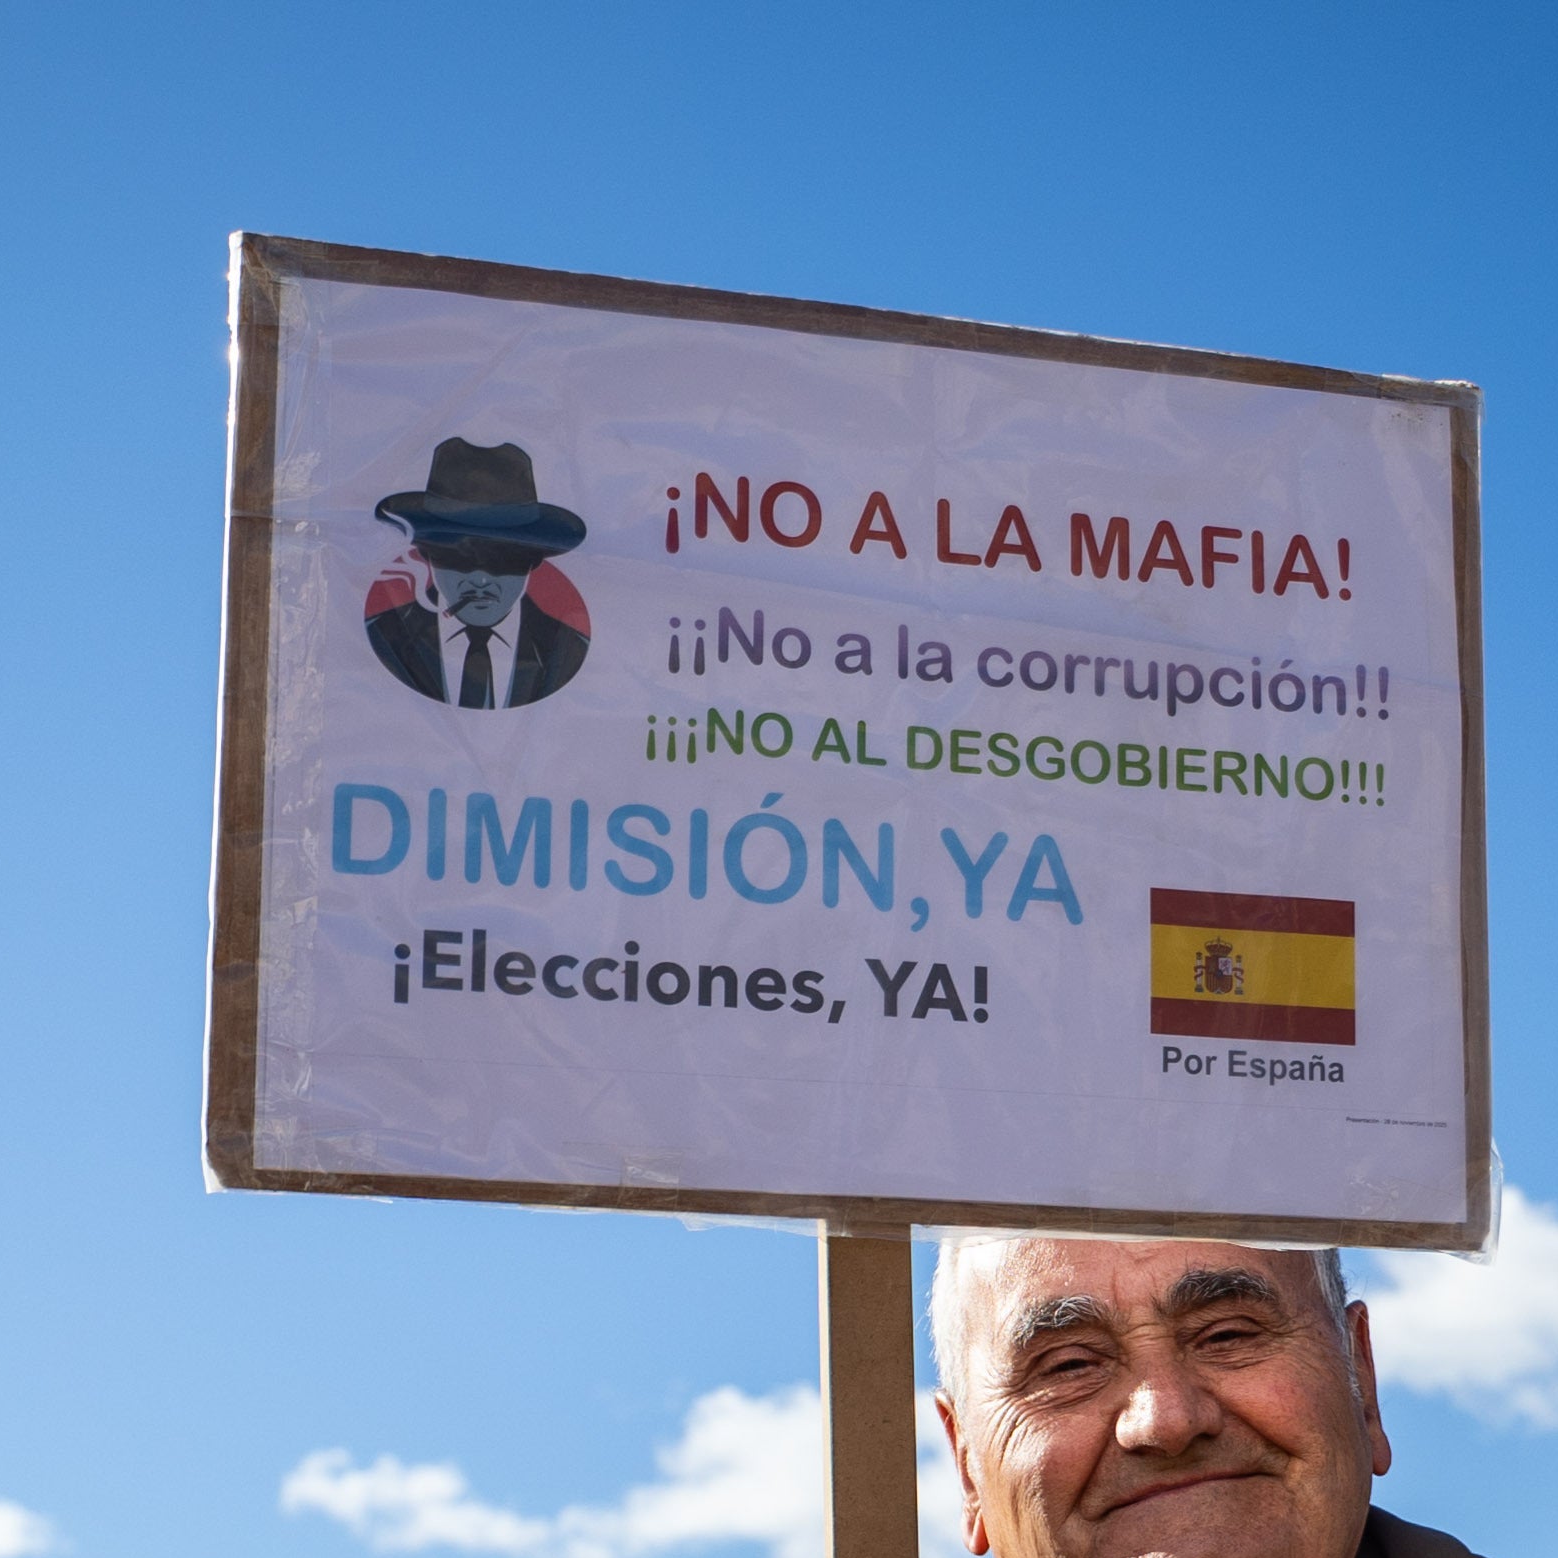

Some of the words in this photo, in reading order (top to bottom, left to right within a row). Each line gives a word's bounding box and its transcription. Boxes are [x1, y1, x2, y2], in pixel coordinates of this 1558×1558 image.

[665, 471, 823, 555] ¡NO
[849, 490, 908, 560] A
[936, 497, 1043, 573] LA
[1069, 512, 1351, 602] MAFIA!
[668, 606, 812, 676] ¡¡No
[834, 633, 873, 676] a
[897, 624, 954, 684] la
[977, 646, 1390, 721] corrupción!!
[645, 707, 794, 765] ¡¡¡NO
[811, 717, 888, 768] AL
[906, 725, 1385, 807] DESGOBIERNO!!!
[393, 929, 847, 1024] ¡Elecciones,
[864, 958, 990, 1024] YA!
[1162, 1045, 1218, 1077] Por
[1228, 1049, 1345, 1087] España
